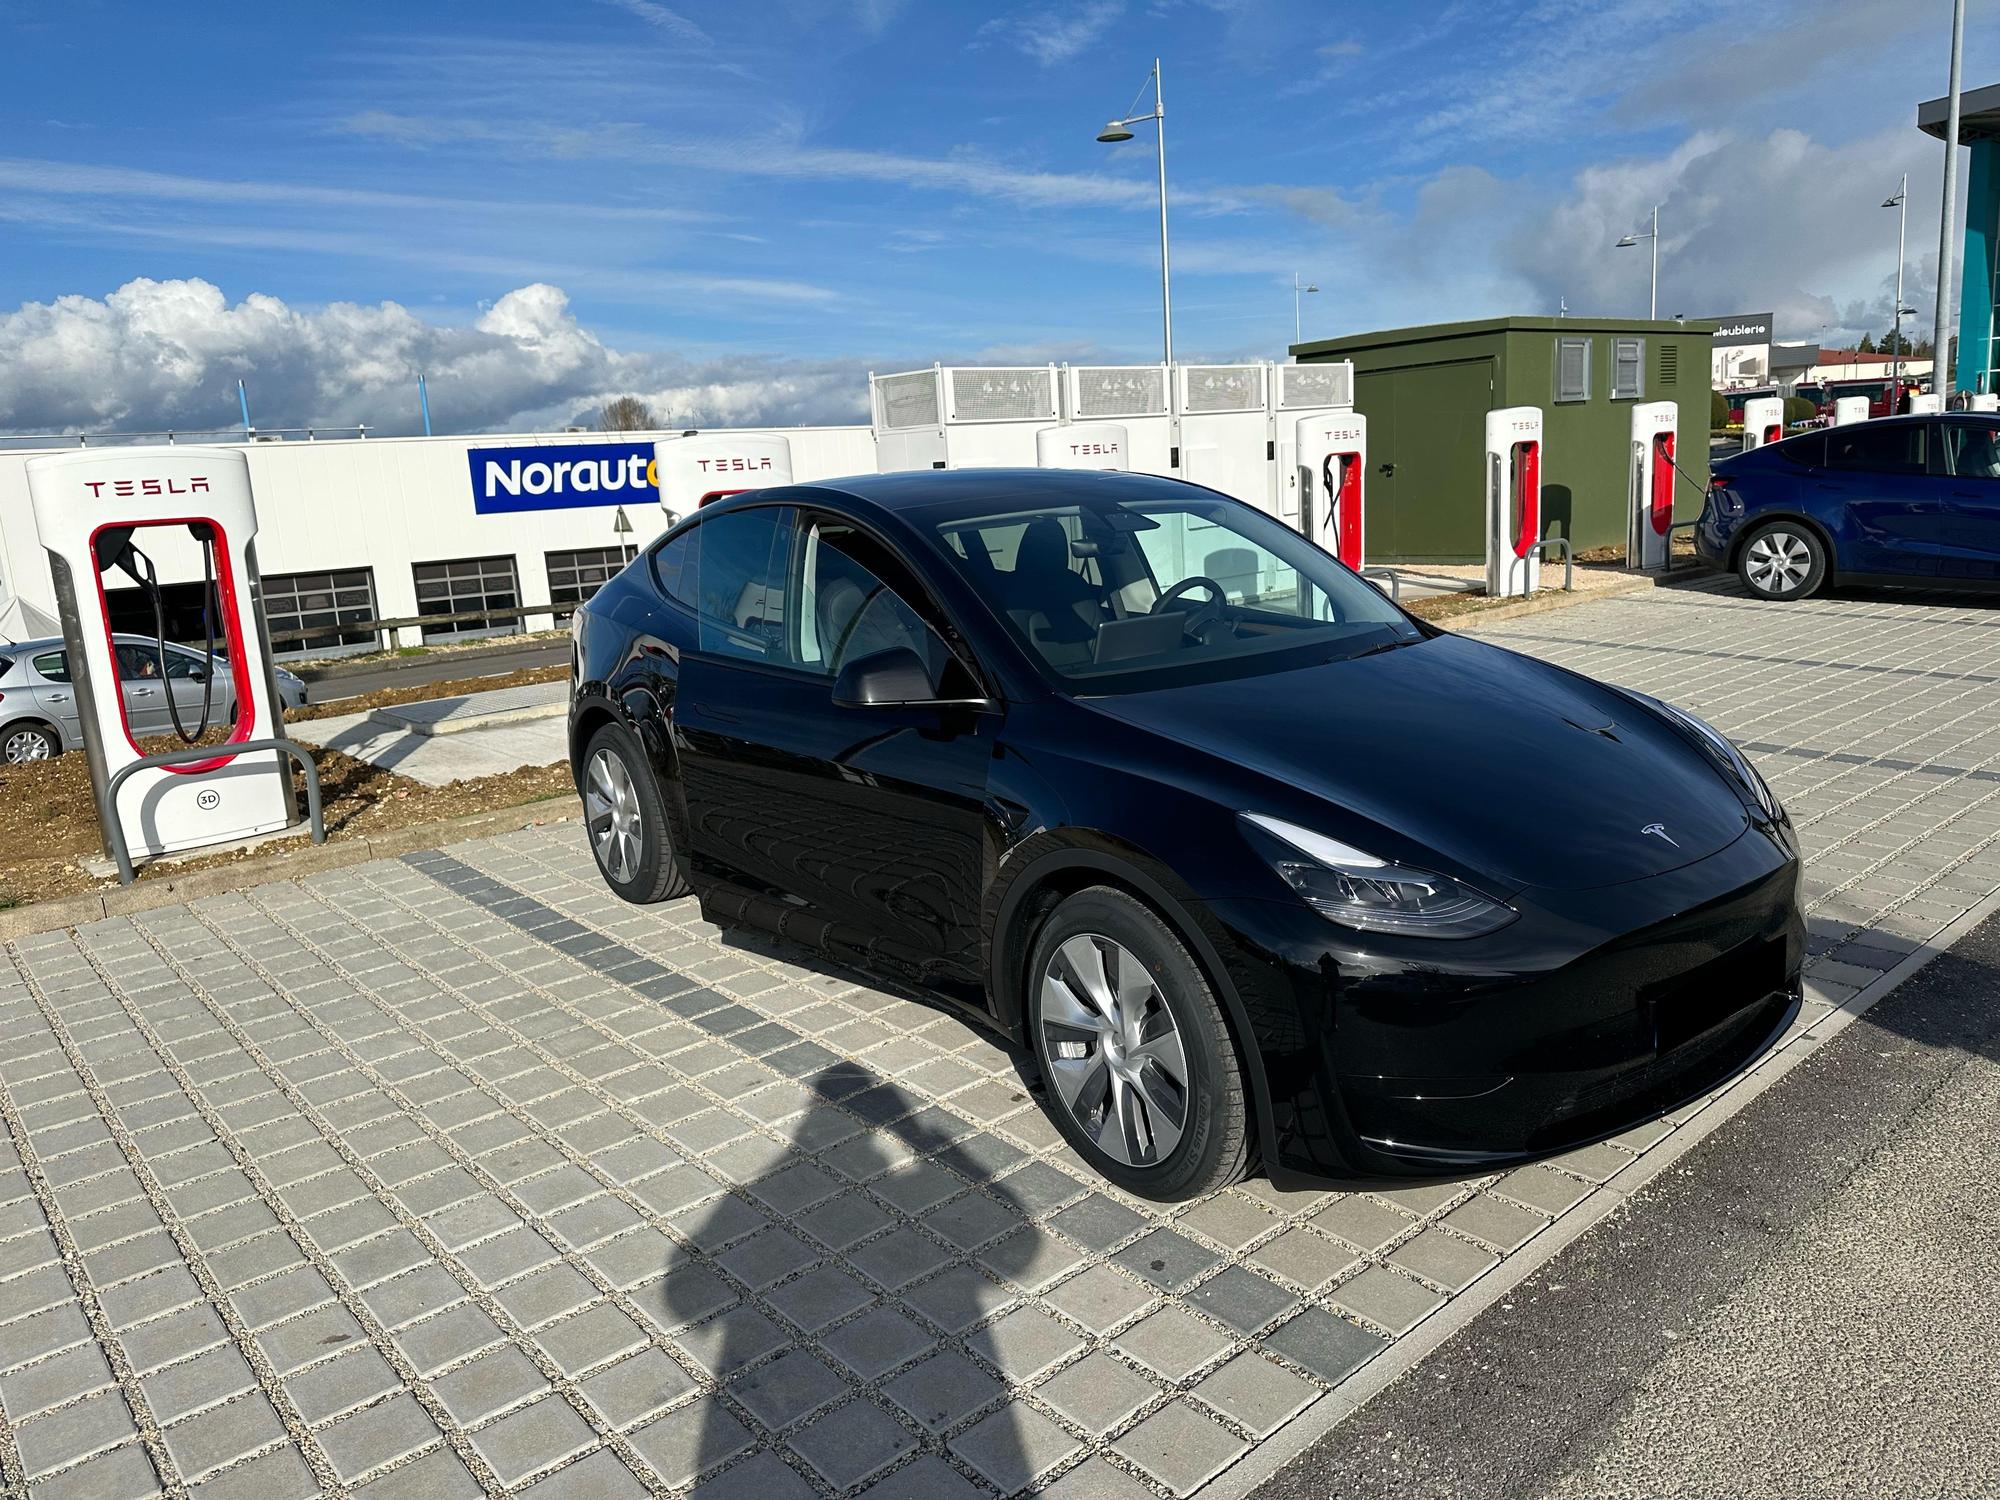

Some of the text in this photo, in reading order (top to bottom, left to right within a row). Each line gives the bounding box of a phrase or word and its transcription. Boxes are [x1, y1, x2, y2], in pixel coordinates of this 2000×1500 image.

[1511, 421, 1539, 430] TESLA
[1324, 429, 1360, 440] TESLA
[1069, 443, 1118, 456] TESLA
[697, 457, 772, 473] TESLA
[83, 477, 210, 498] TESLA
[200, 794, 217, 805] 3D
